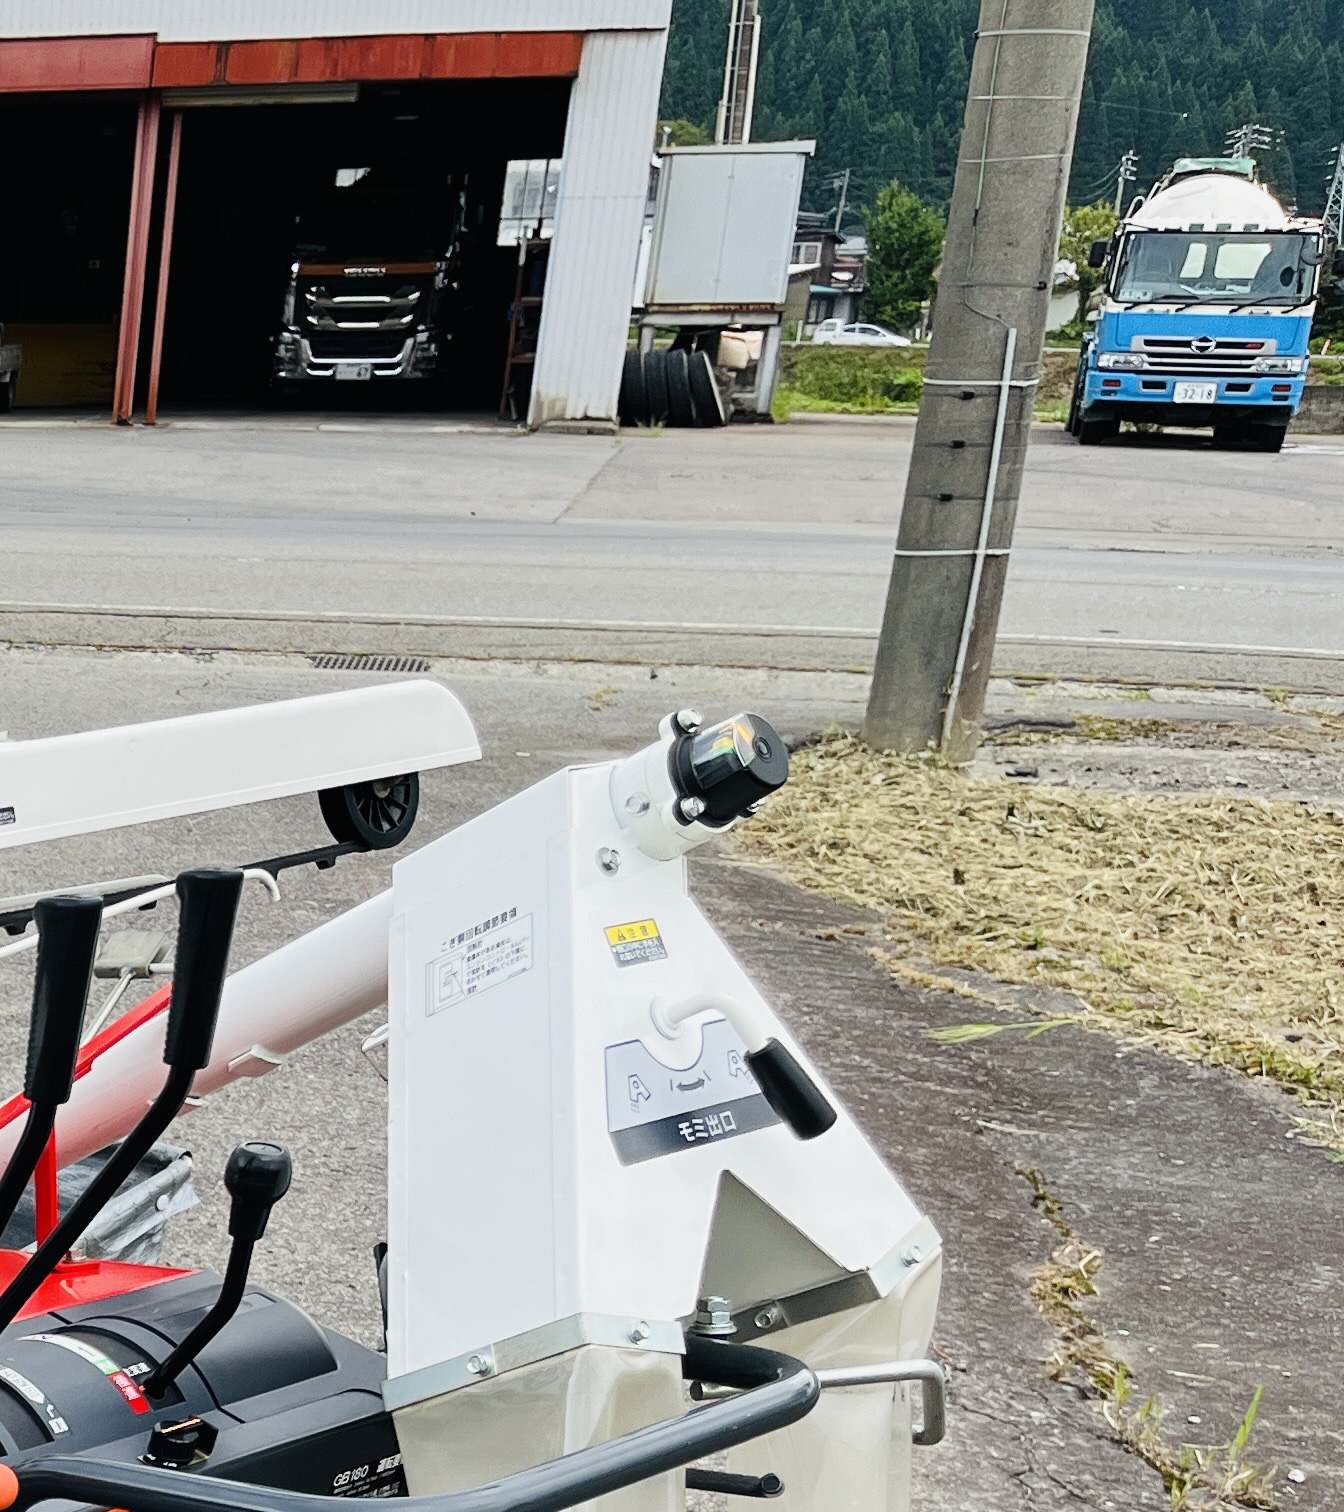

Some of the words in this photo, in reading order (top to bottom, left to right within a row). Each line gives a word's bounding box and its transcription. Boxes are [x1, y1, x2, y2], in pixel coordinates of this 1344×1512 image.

[677, 1110, 737, 1142] モミ出口
[333, 1465, 369, 1487] GB180
